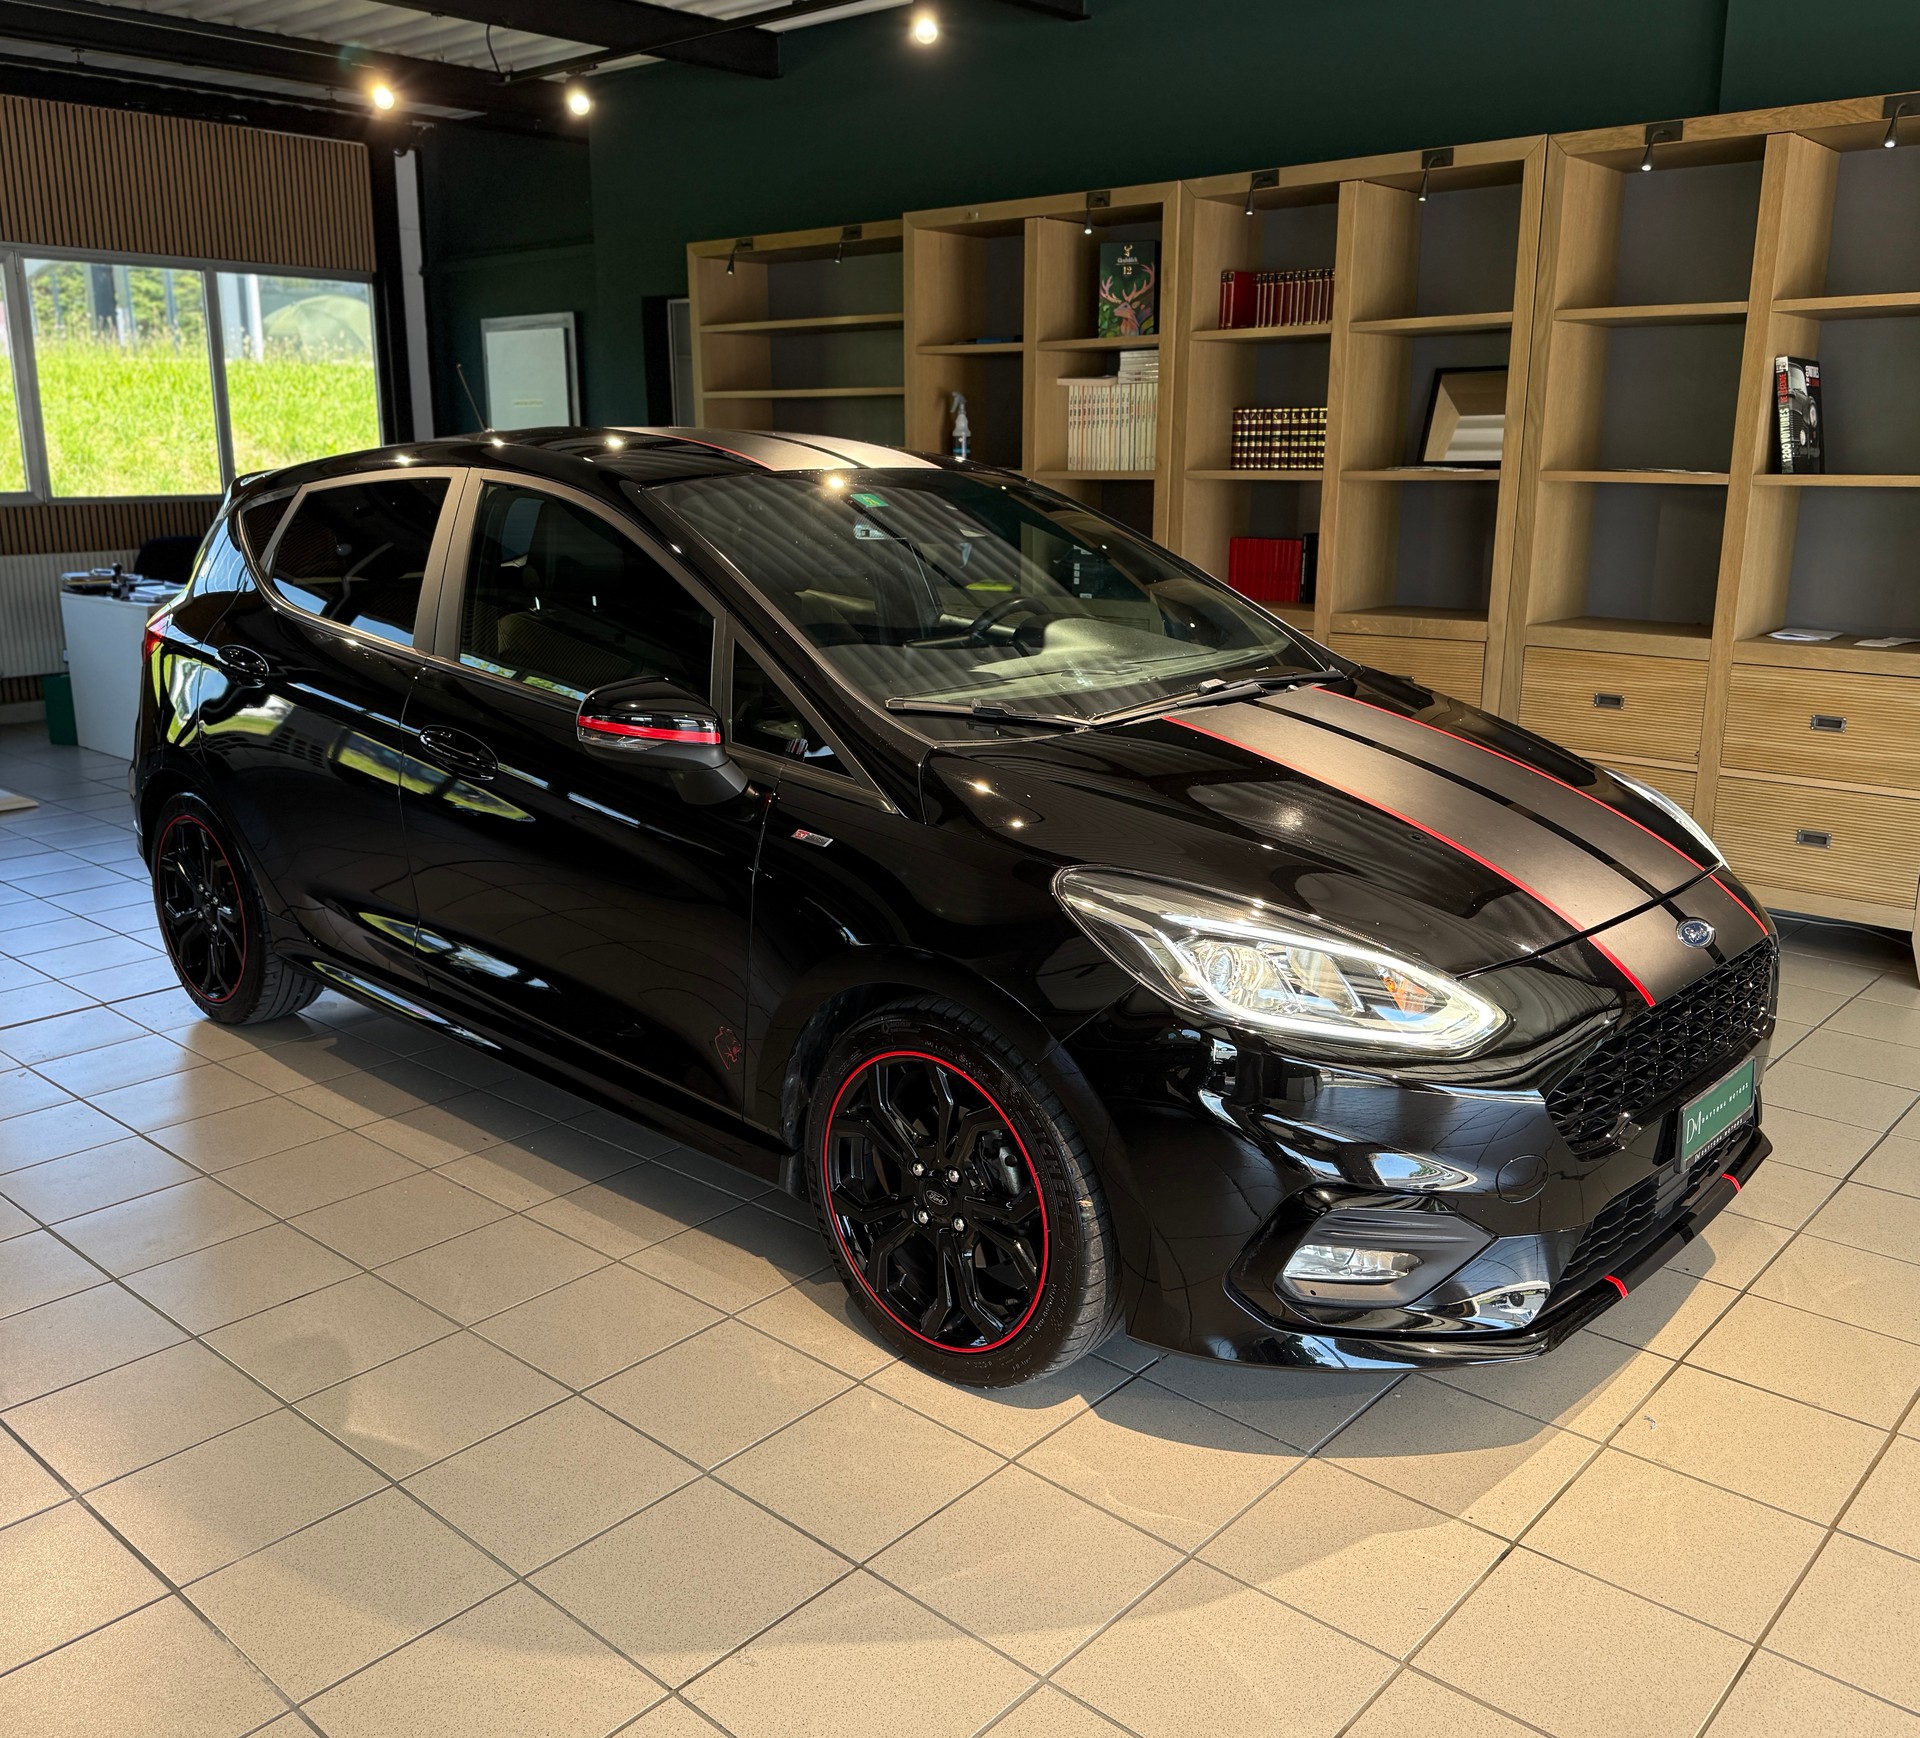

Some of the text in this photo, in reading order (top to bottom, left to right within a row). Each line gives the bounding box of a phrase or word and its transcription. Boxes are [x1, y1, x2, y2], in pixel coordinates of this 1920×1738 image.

[1123, 266, 1133, 275] 12
[1779, 407, 1791, 444] VOITURES
[1782, 443, 1793, 463] 1200
[1729, 1082, 1749, 1102] MOTORS
